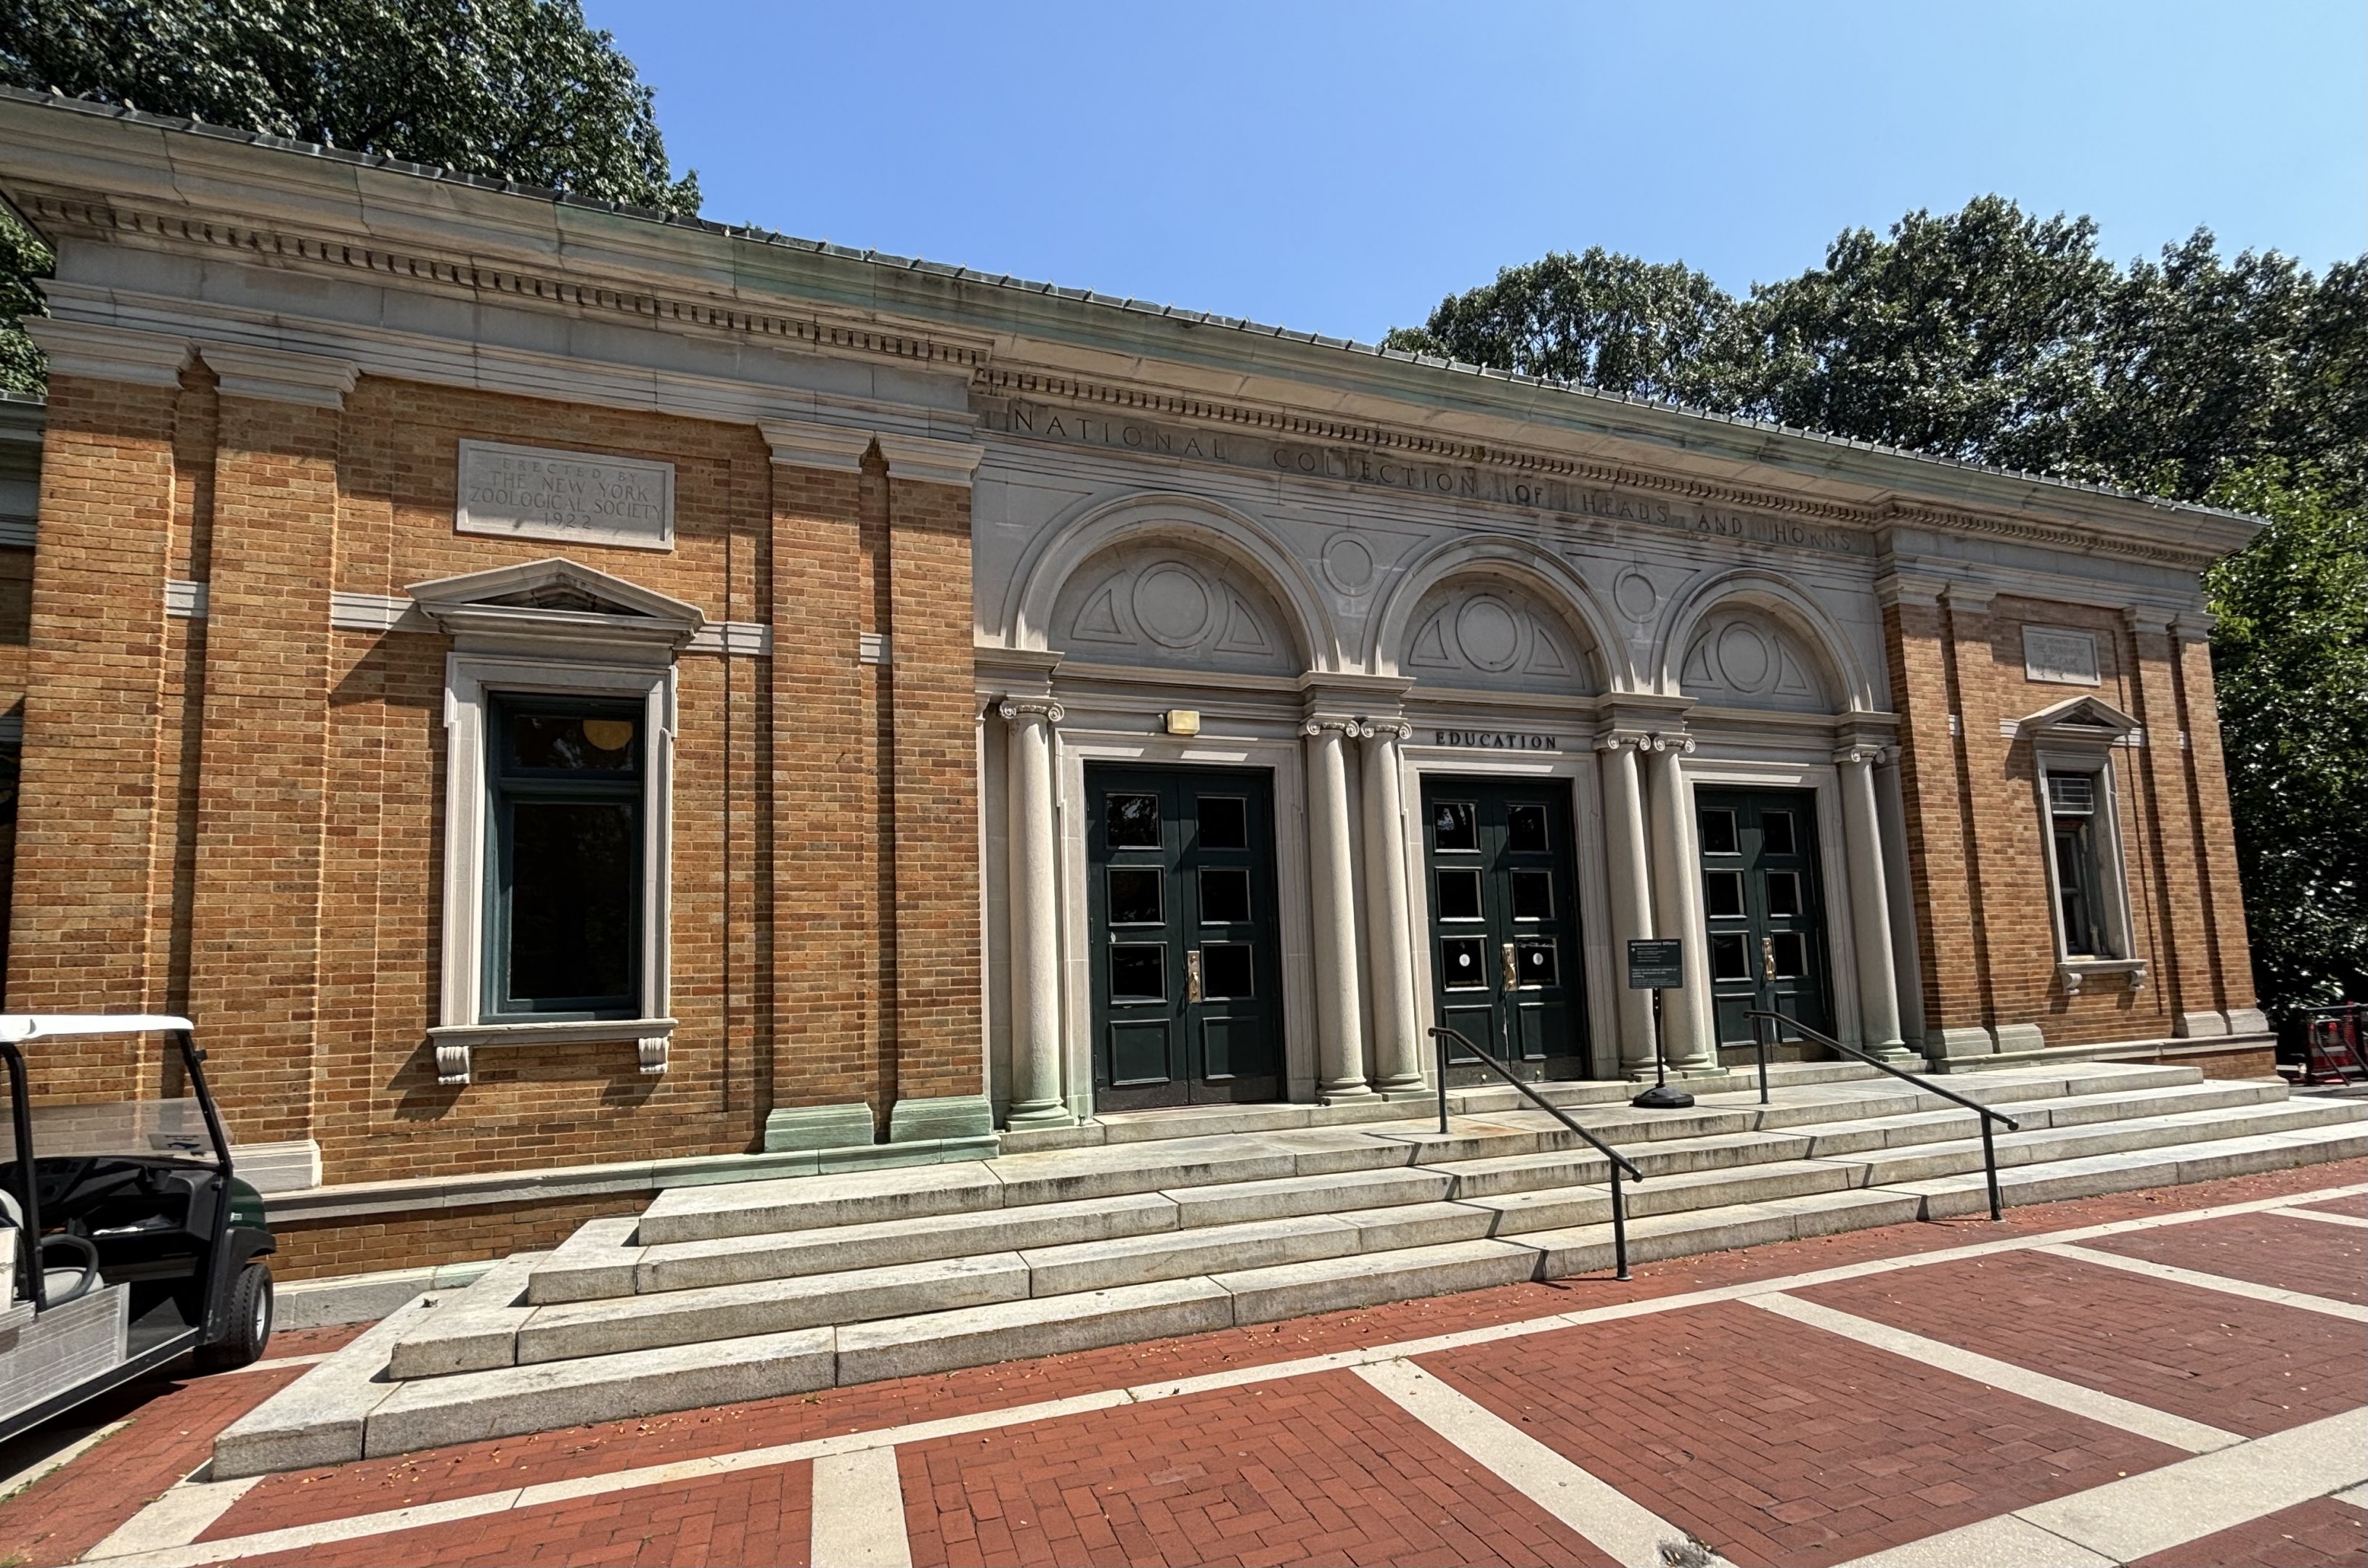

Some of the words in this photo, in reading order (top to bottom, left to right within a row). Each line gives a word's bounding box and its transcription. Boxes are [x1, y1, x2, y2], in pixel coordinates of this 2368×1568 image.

[502, 459, 601, 478] ERECTED
[618, 472, 638, 483] BY
[1016, 408, 1226, 460] NATIONAL
[1273, 449, 1475, 494] COLLECTION
[1515, 484, 1543, 504] OF
[1583, 494, 1667, 523] HEADS
[1698, 514, 1742, 534] AND
[491, 470, 526, 489] THE
[542, 476, 586, 494] NEW
[599, 483, 649, 502] YORK
[470, 486, 588, 513] ZOOLOGICAL
[593, 499, 663, 520] SOCIETY
[544, 512, 592, 529] 1922
[1435, 731, 1556, 748] EDUCATION
